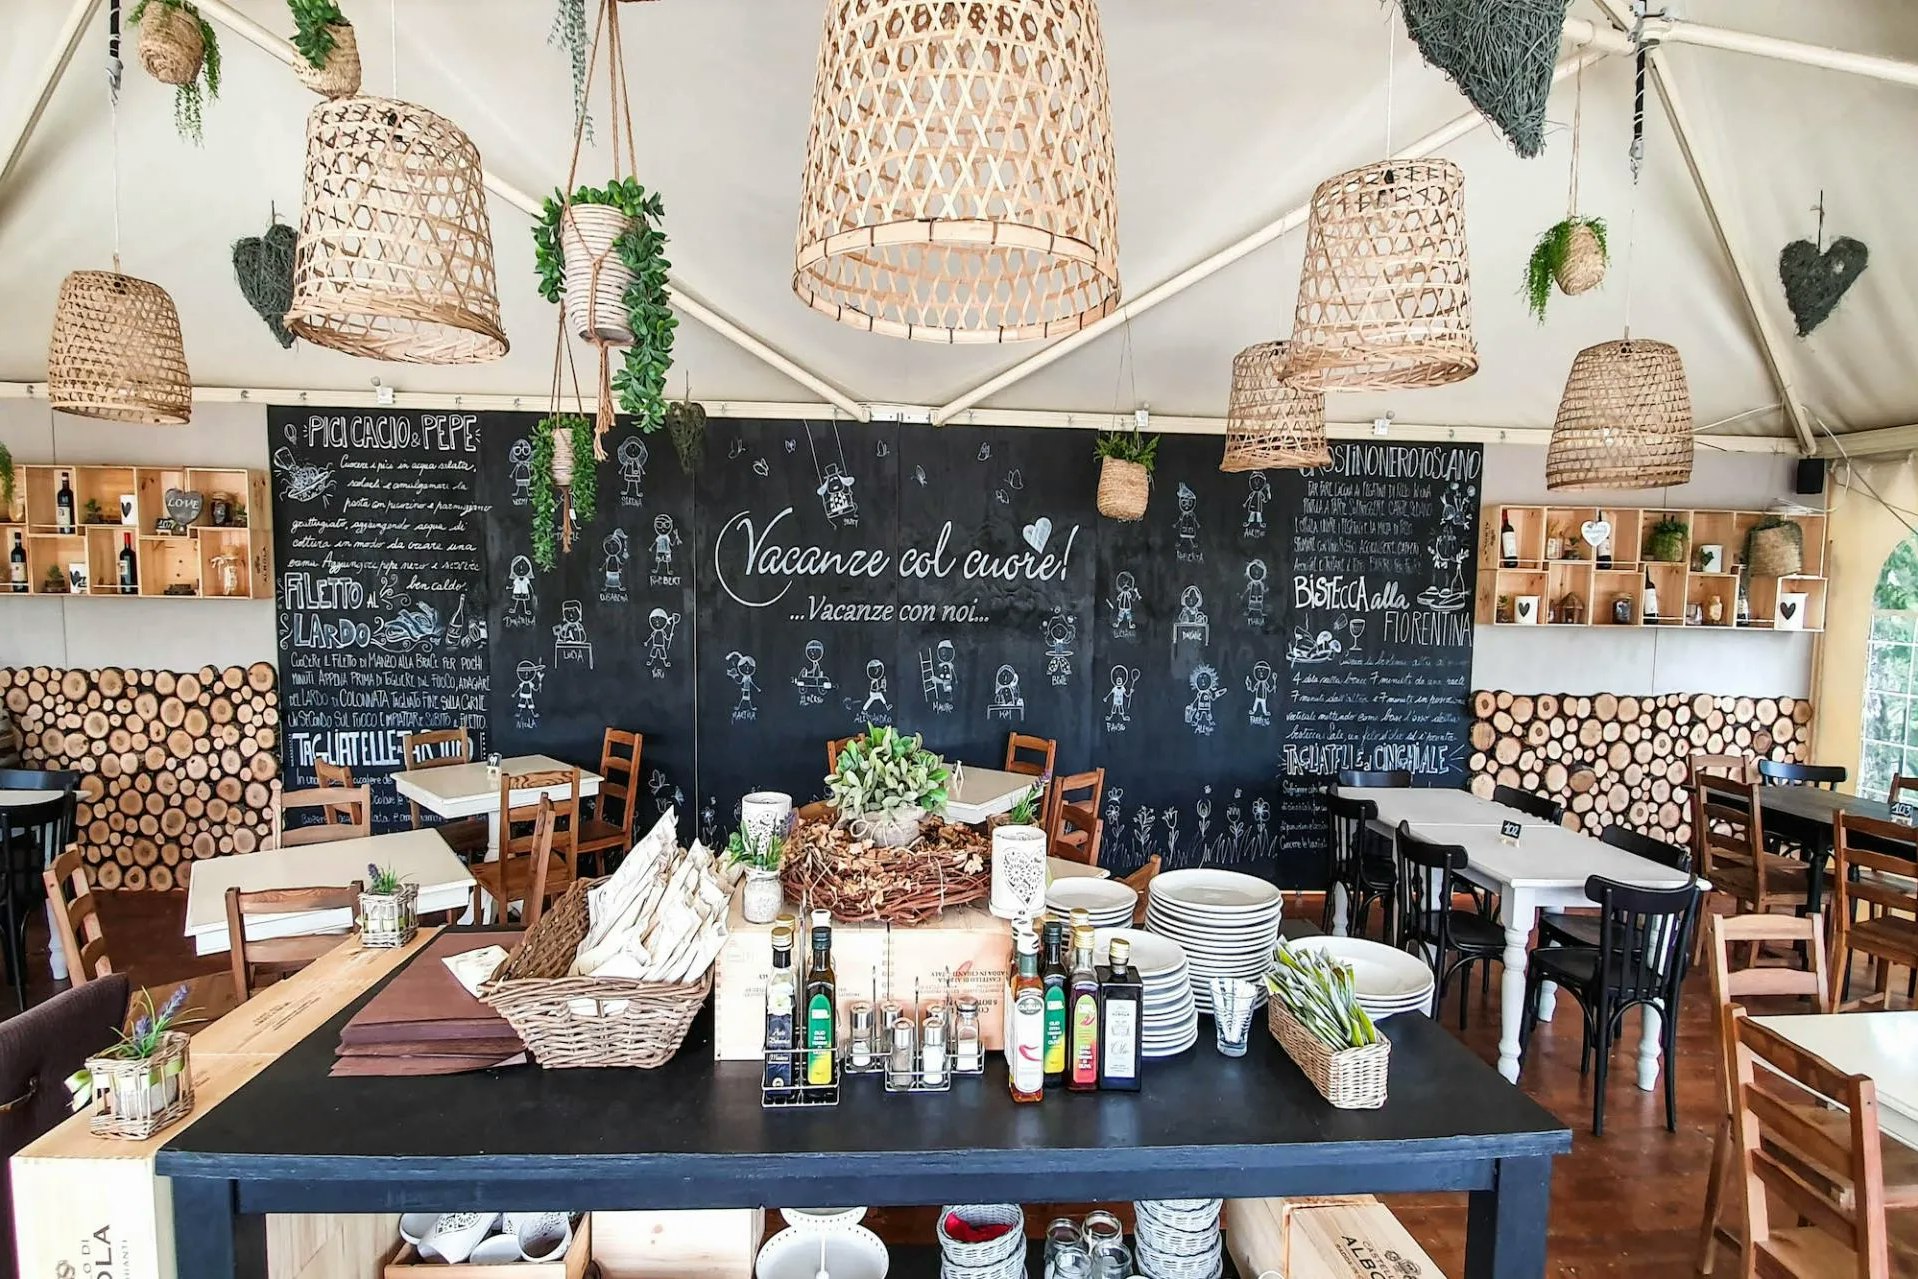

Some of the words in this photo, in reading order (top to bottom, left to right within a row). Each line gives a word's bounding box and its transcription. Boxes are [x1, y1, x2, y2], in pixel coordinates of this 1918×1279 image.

[308, 415, 348, 448] PICI
[352, 416, 411, 449] CACIO
[411, 432, 421, 447] &
[421, 414, 477, 451] PEPE
[168, 498, 199, 510] LOVE
[343, 497, 370, 513] pasta
[292, 534, 331, 548] cottura
[446, 543, 477, 551] una
[734, 506, 891, 578] Vacanze
[899, 520, 957, 579] col
[963, 523, 1080, 582] cuore!
[284, 572, 364, 610] FILETTO
[366, 592, 379, 609] AL
[1293, 574, 1370, 612] BISTECCA
[1370, 581, 1410, 610] alla
[899, 602, 936, 623] con
[293, 613, 371, 649] LARDO
[1384, 609, 1473, 648] FIORENTINA
[398, 655, 414, 669] ALLA
[461, 655, 483, 670] POCHI
[1370, 671, 1379, 685] 7
[1291, 689, 1300, 703] 7
[1379, 691, 1387, 703] 7
[293, 729, 400, 767] TAGLIATELLE
[1374, 742, 1451, 775] CINGHIALE
[1891, 802, 1911, 817] 103
[1504, 822, 1519, 837] 102
